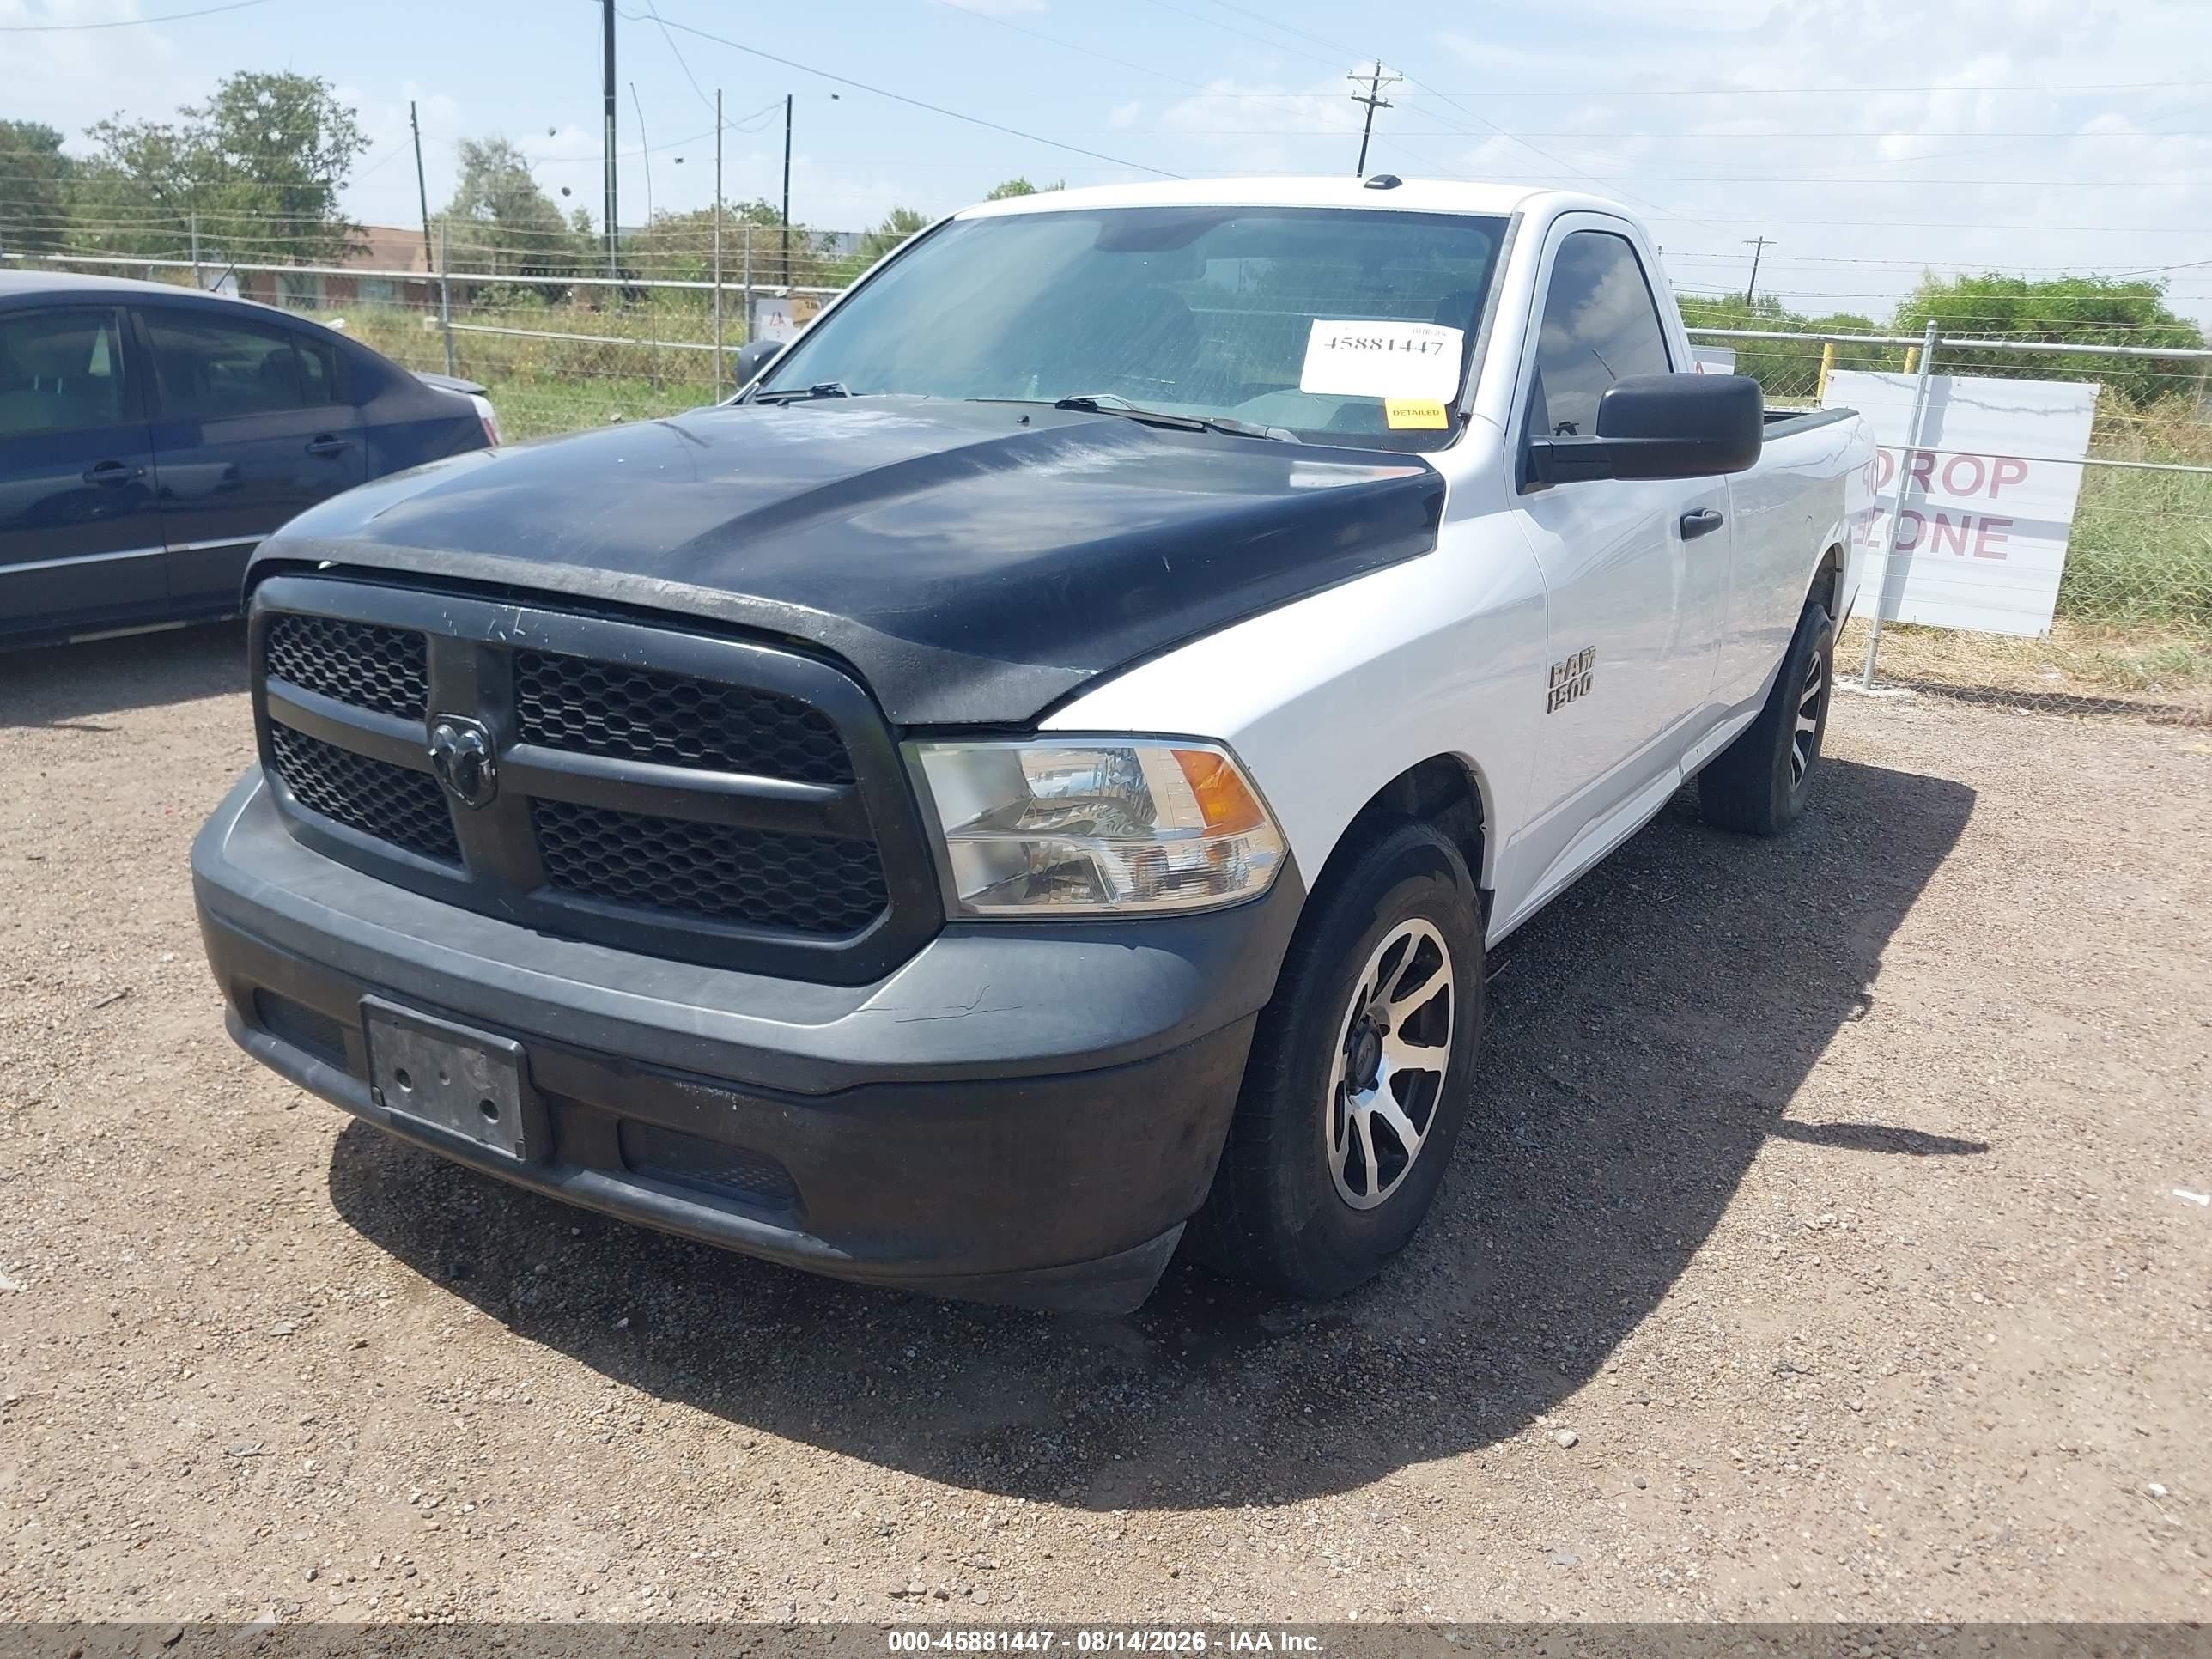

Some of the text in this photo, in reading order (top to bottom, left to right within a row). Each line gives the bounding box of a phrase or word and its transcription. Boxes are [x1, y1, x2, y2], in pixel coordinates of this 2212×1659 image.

[1323, 337, 1444, 356] 45881447
[1392, 409, 1440, 417] DETAILED
[1549, 645, 1596, 689] RAM
[1547, 672, 1595, 714] 1500
